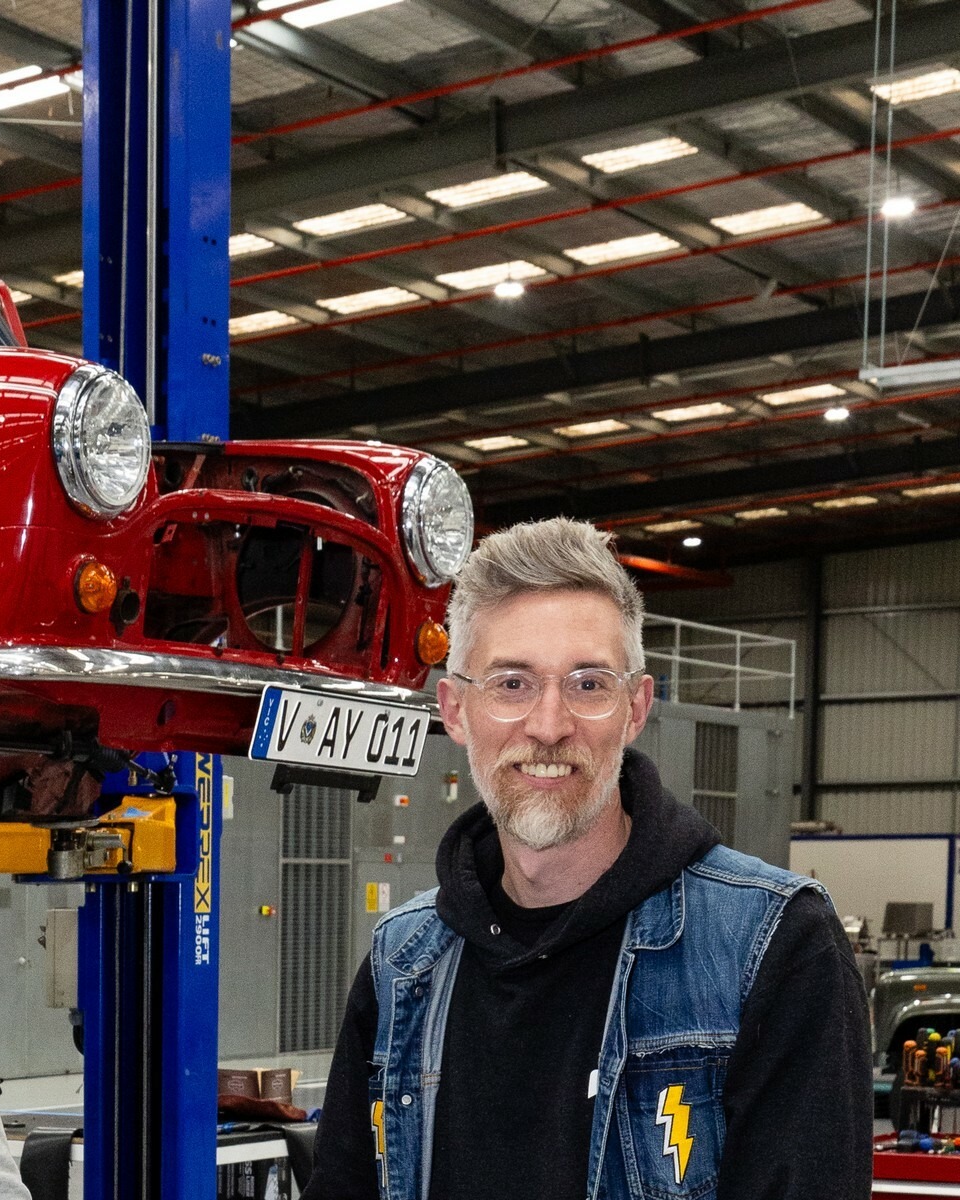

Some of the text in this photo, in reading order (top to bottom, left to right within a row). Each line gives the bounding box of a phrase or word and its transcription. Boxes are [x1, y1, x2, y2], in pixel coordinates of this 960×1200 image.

[264, 698, 275, 727] VIC
[277, 699, 421, 767] V AY 011
[202, 915, 210, 965] LIFT
